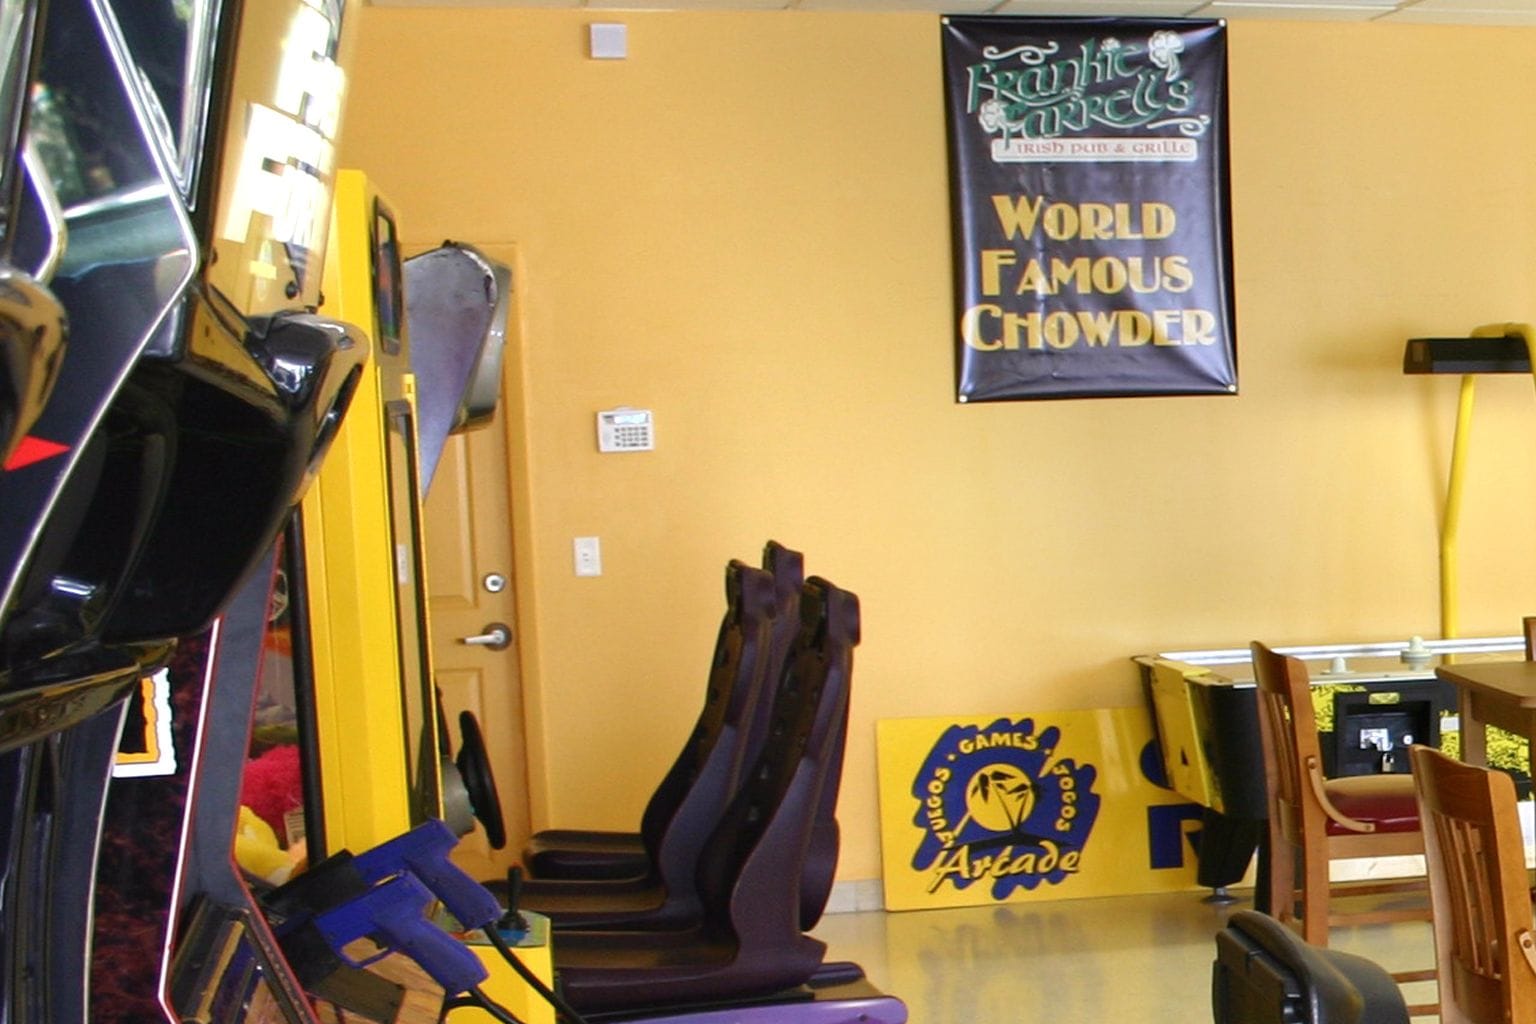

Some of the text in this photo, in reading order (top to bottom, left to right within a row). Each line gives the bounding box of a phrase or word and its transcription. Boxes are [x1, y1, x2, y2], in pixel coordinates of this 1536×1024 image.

[1114, 142, 1126, 154] &
[992, 195, 1176, 240] WORLD
[981, 250, 1194, 296] FAMOUS
[961, 303, 1216, 351] CHOWDER
[959, 732, 1038, 754] GAMES
[928, 840, 1079, 893] Arcade
